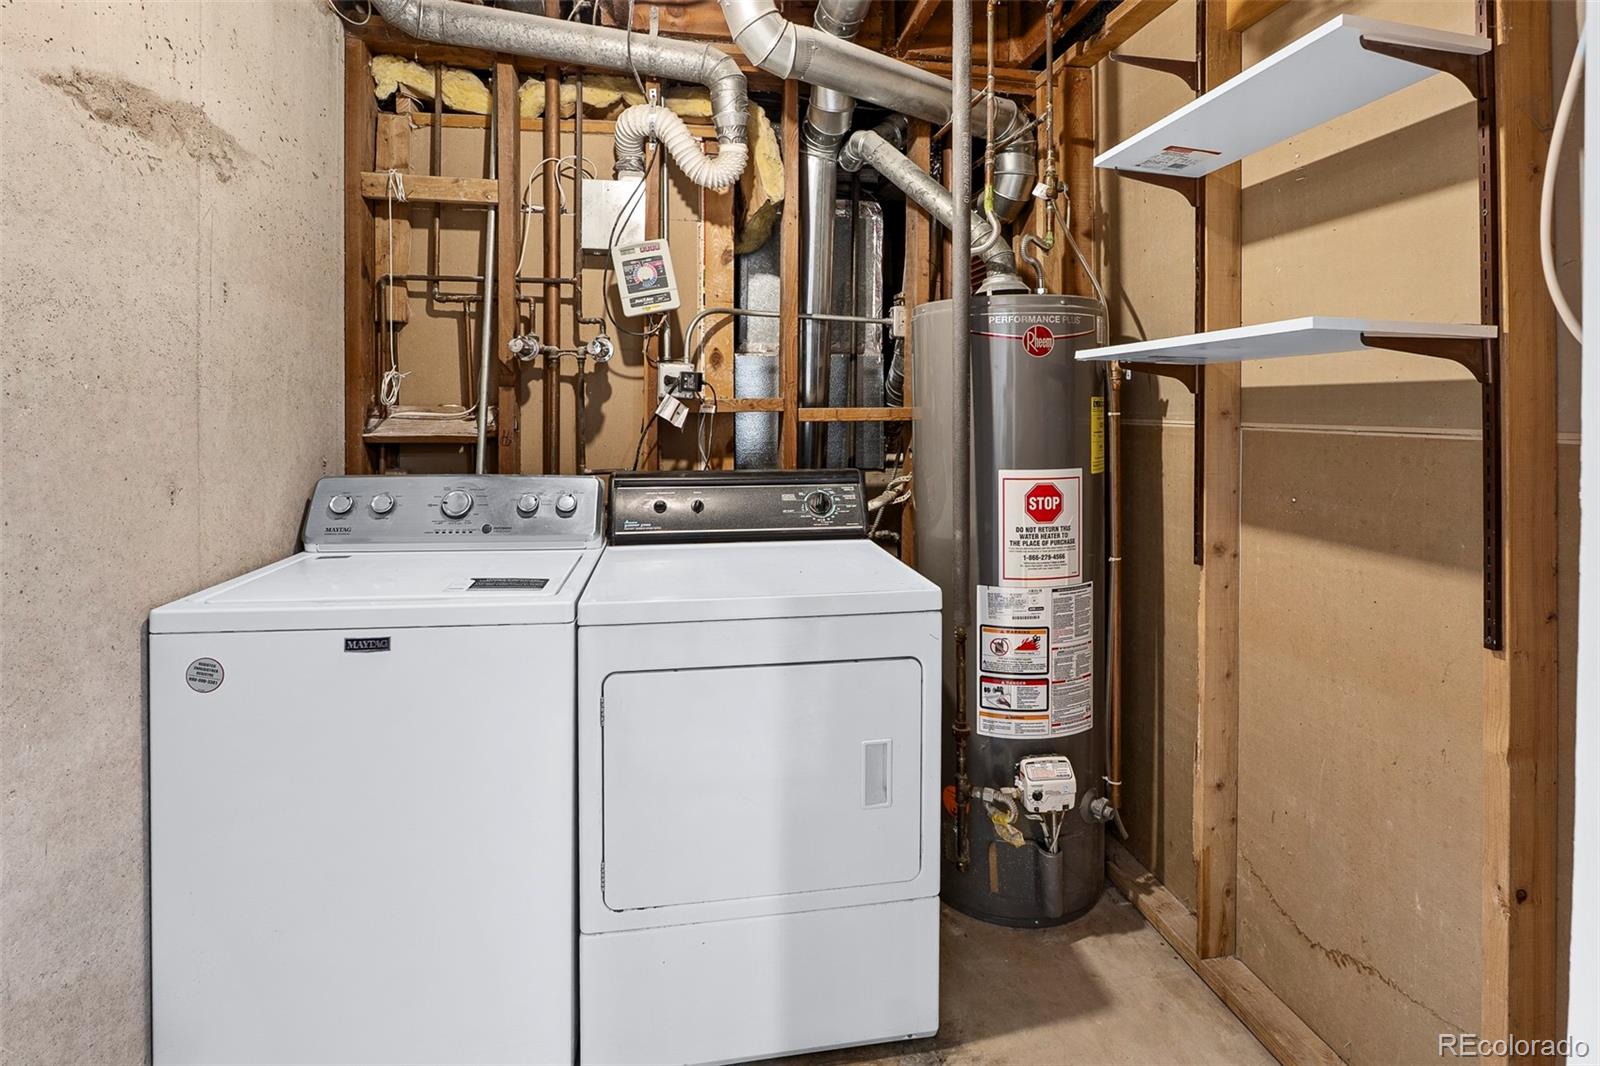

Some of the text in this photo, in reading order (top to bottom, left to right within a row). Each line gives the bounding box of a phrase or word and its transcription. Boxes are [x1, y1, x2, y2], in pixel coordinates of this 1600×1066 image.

[988, 315, 1081, 324] PERFORMANCE PLUS
[1026, 325, 1053, 352] Rheem
[1028, 496, 1060, 511] STOP
[1050, 538, 1076, 546] PURCHASE
[346, 640, 389, 649] MAYTAG
